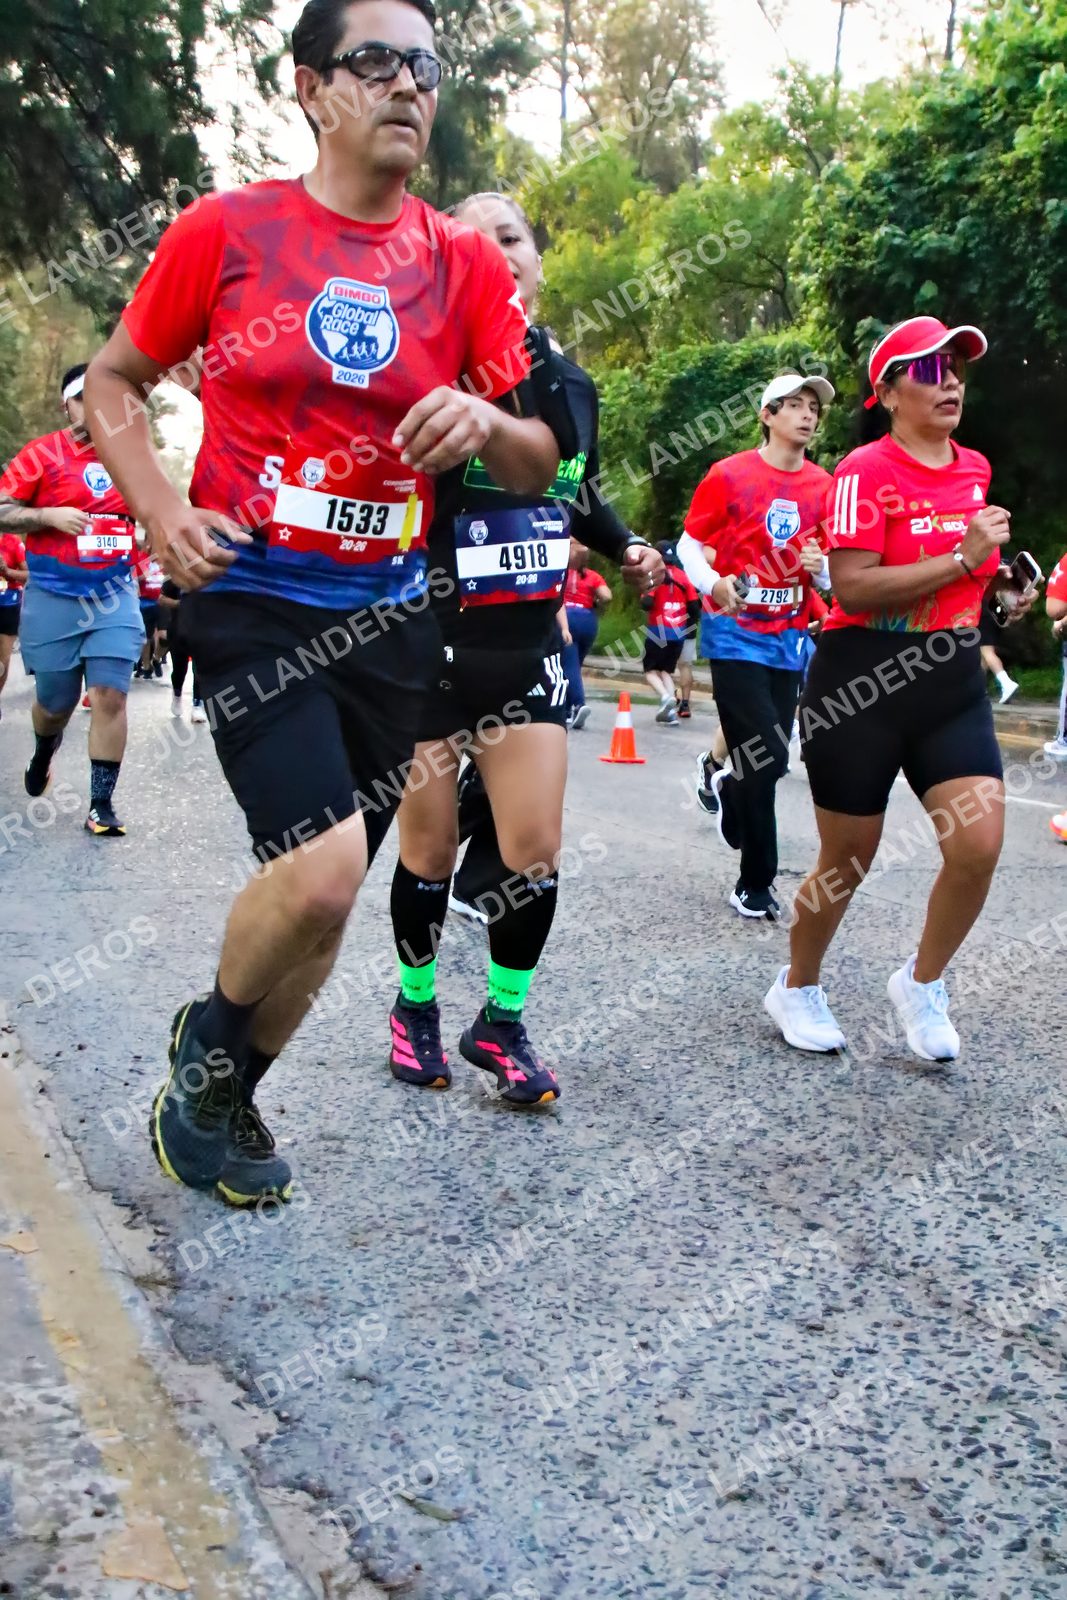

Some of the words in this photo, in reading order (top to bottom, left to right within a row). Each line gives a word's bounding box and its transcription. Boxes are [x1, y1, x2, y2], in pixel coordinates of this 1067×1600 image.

[333, 286, 381, 304] BIMBO
[332, 302, 379, 325] Global
[320, 314, 360, 336] Race
[336, 370, 366, 384] 2026
[326, 498, 390, 535] 1533
[96, 536, 118, 548] 3140
[499, 542, 548, 571] 4918
[760, 589, 789, 604] 2792
